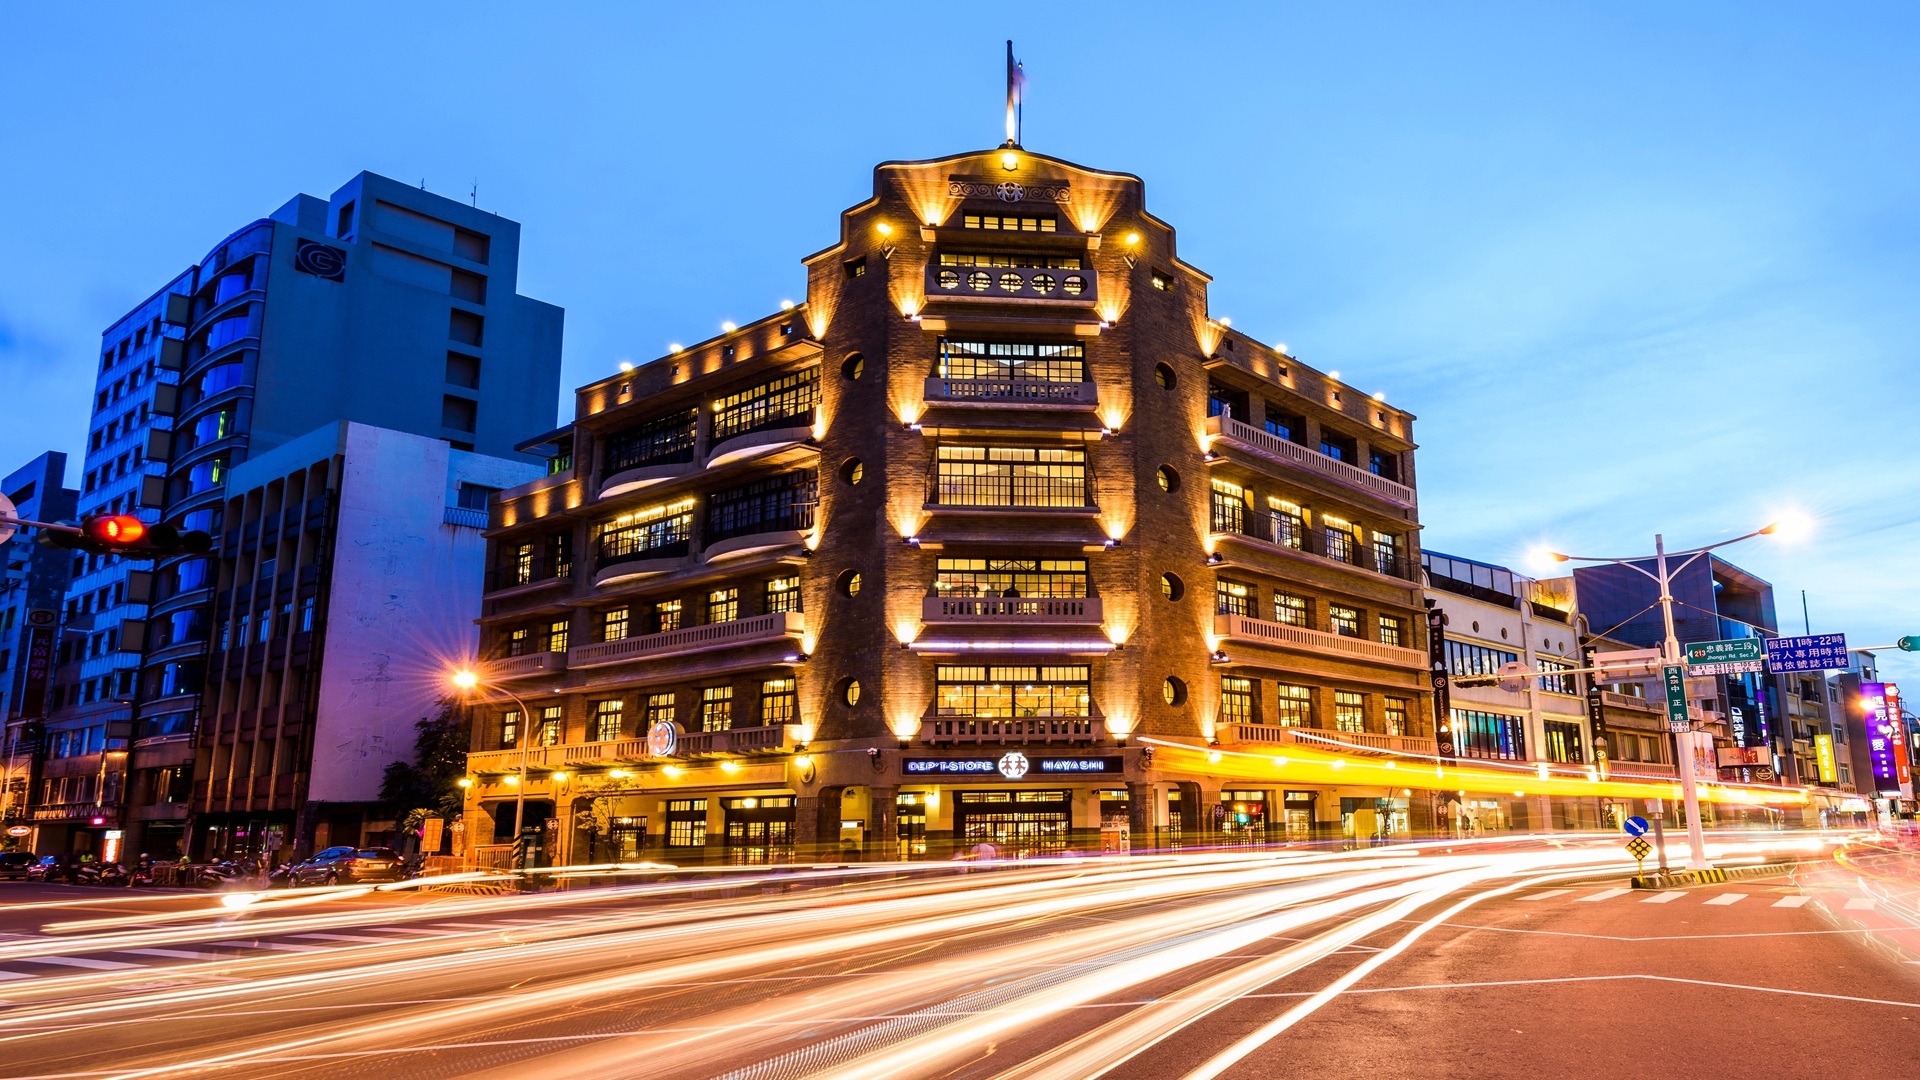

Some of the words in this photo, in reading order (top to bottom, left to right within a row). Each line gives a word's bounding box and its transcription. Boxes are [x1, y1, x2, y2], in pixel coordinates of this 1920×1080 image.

[1694, 648, 1706, 657] 213
[1706, 641, 1753, 653] 忠義路二段
[1769, 646, 1847, 660] 行人專用時相
[1706, 653, 1727, 661] Jhongyi
[1770, 657, 1848, 671] 請依號誌行駛
[1670, 685, 1684, 721] 中正路
[1042, 760, 1104, 771] HAYASHI
